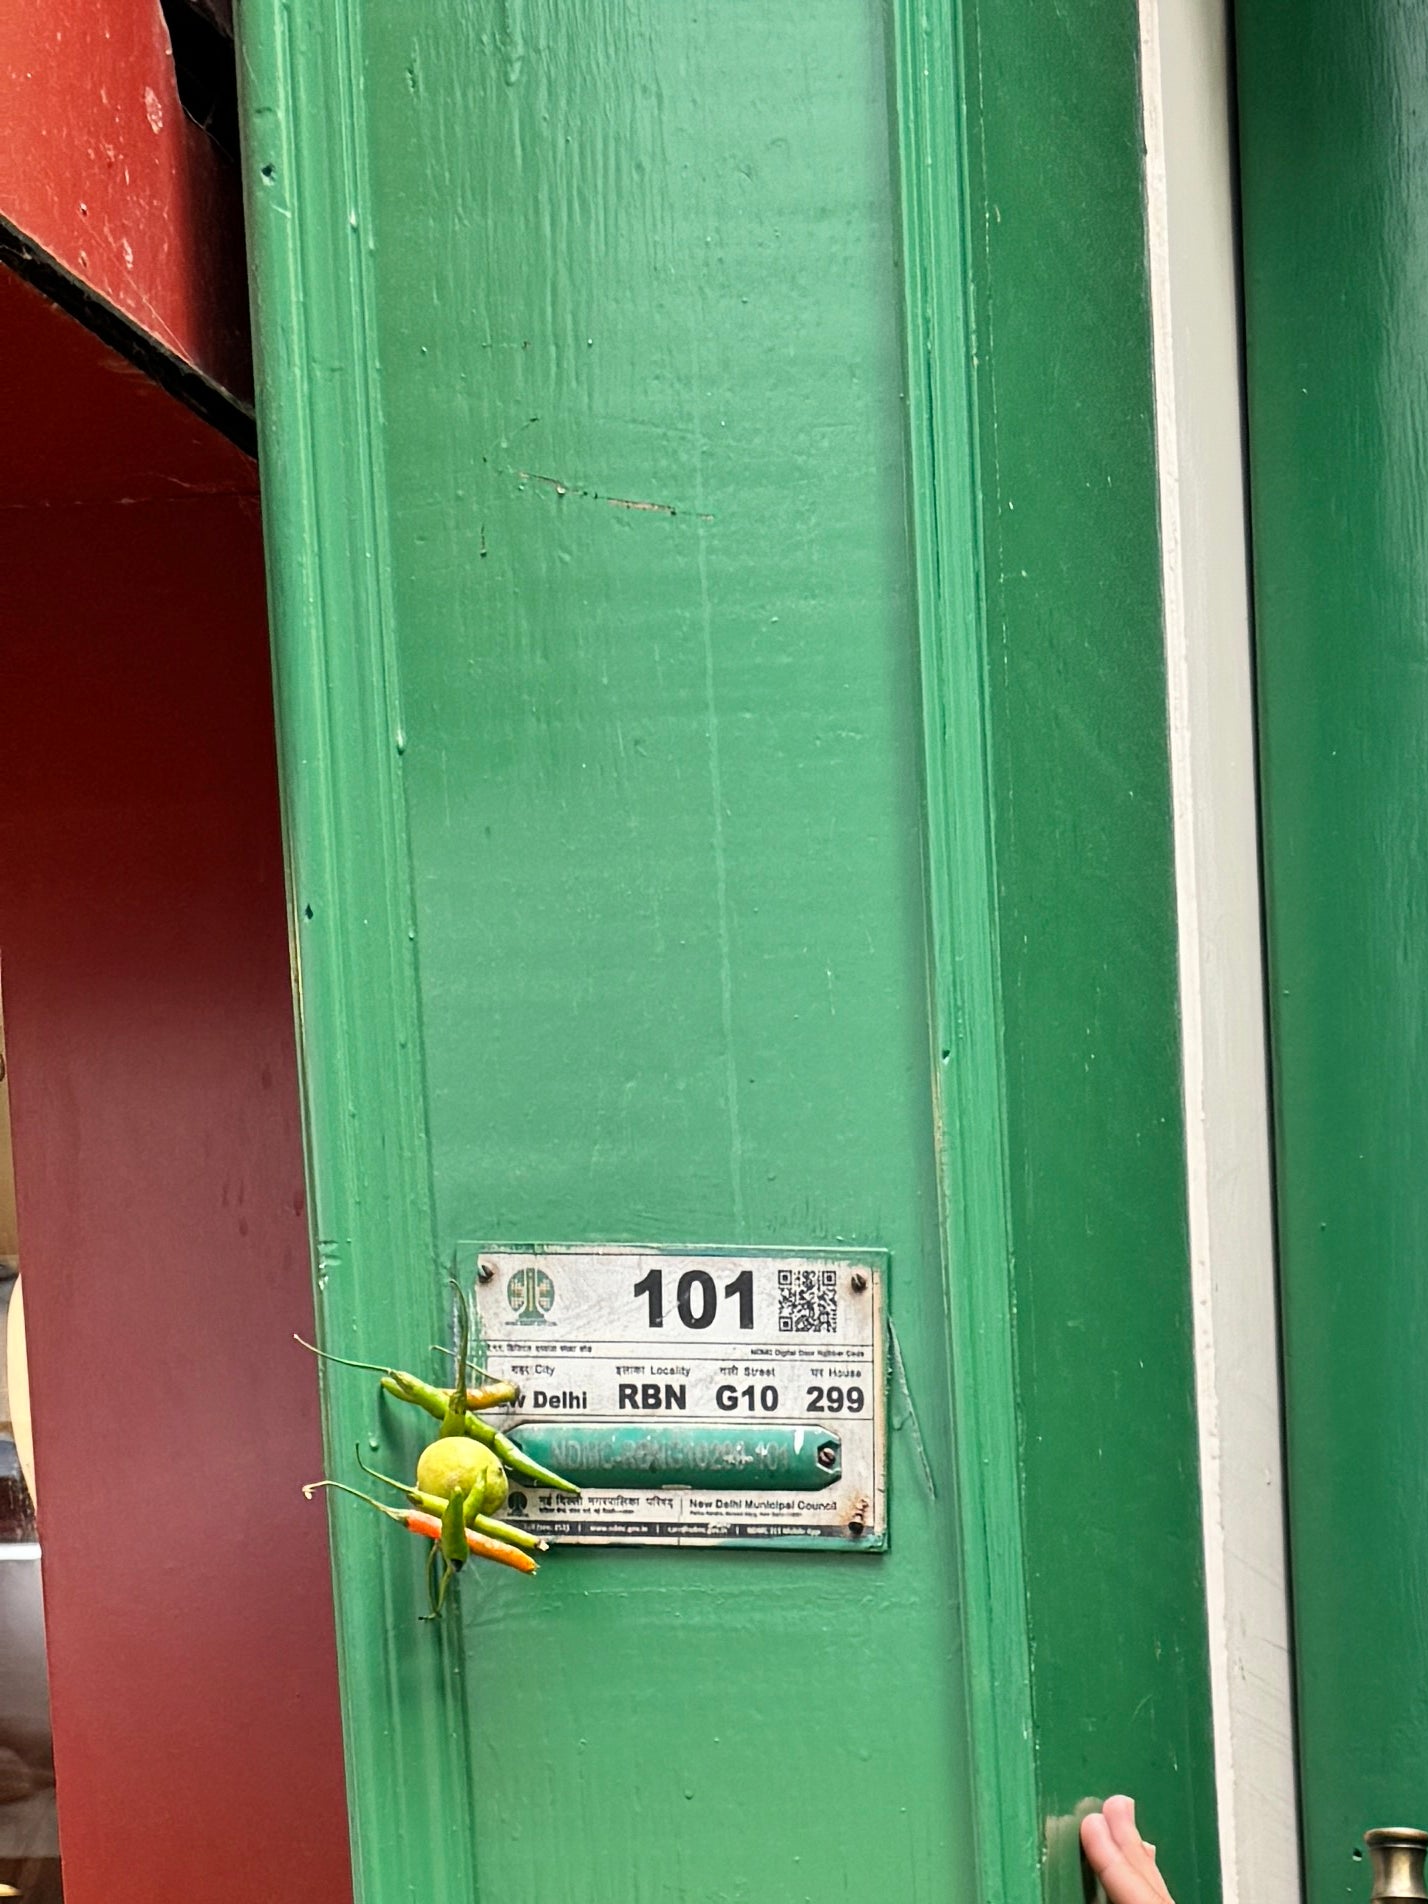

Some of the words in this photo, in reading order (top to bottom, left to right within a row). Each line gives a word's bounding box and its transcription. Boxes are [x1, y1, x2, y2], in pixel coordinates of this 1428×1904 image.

[633, 1268, 754, 1329] 101
[534, 1364, 555, 1377] City
[650, 1365, 691, 1378] Locality
[743, 1366, 776, 1377] Street
[828, 1367, 862, 1378] House
[533, 1390, 588, 1410] Delhi
[618, 1383, 687, 1411] RBN
[715, 1384, 779, 1412] G10
[805, 1385, 865, 1413] 299
[689, 1499, 713, 1509] New
[715, 1499, 742, 1510] Delhi
[744, 1499, 795, 1512] Municipal
[797, 1500, 837, 1511] Council
